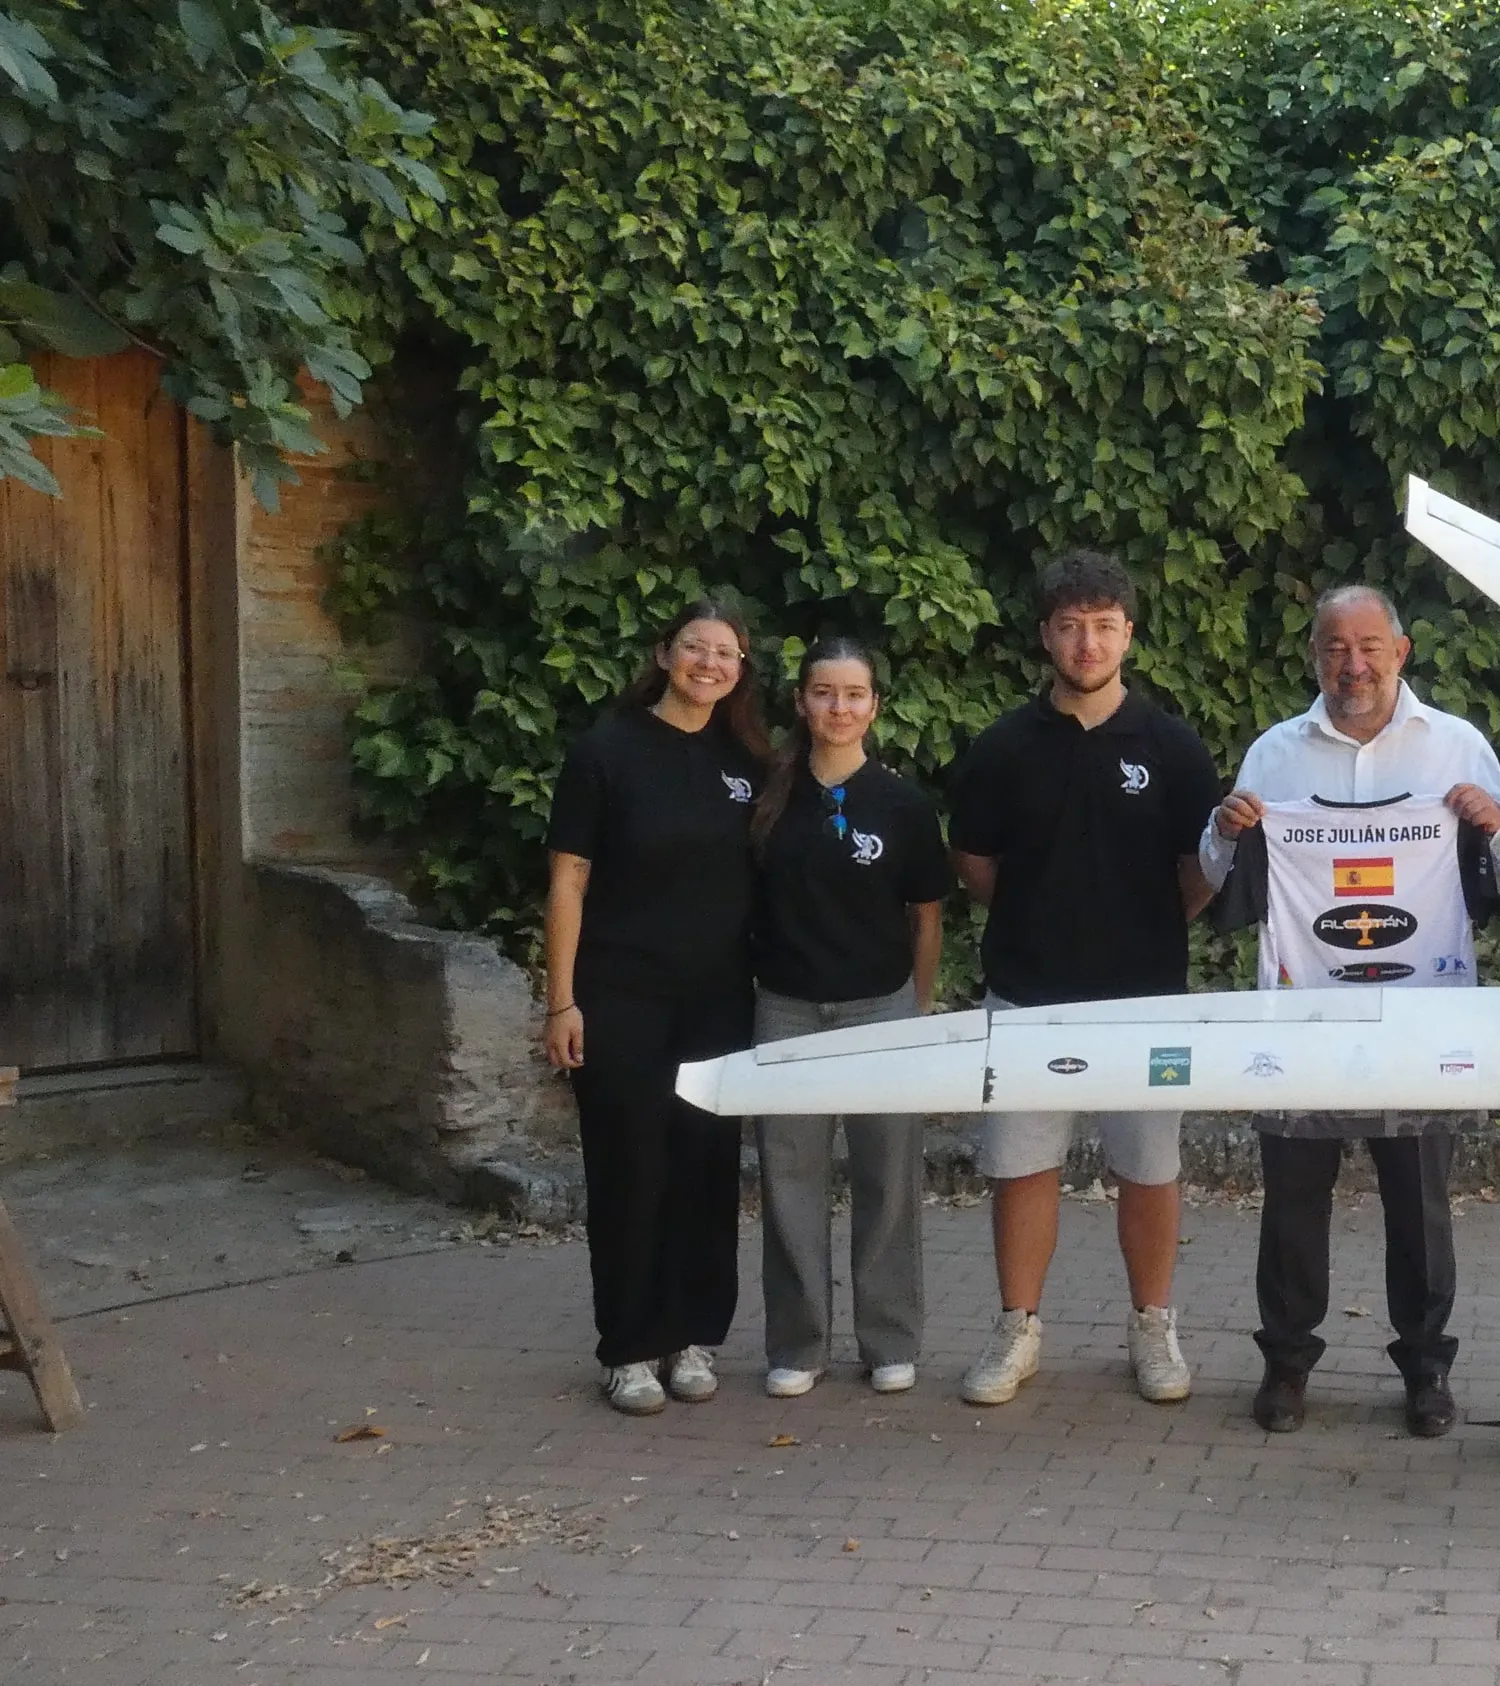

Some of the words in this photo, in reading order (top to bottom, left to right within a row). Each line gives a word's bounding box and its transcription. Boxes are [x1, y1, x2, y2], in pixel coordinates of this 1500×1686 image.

[1283, 828, 1325, 844] JOSE
[1328, 824, 1385, 844] JULIÁN
[1389, 823, 1442, 842] GARDE
